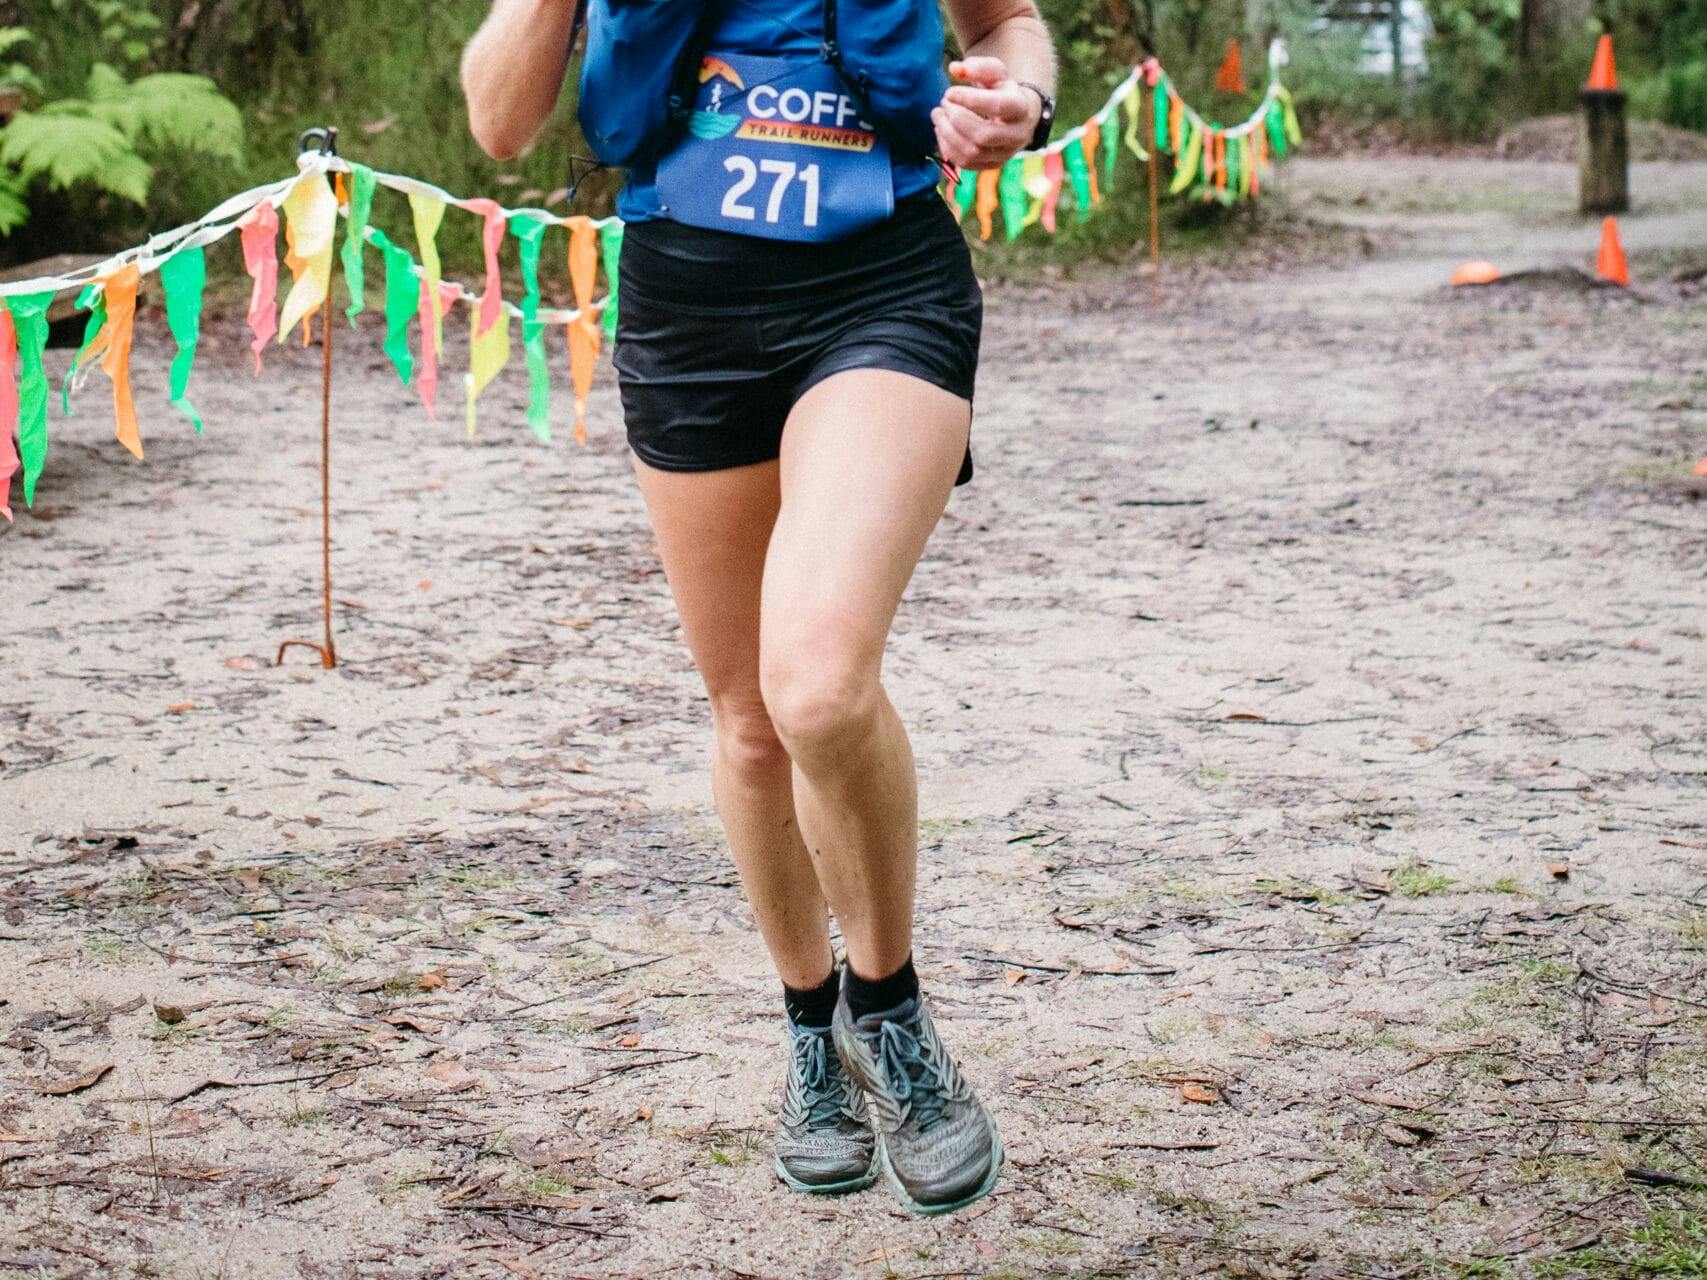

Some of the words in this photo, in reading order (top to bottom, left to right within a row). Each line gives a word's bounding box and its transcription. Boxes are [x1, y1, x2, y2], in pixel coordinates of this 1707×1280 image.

[747, 85, 874, 131] COFF
[750, 124, 793, 138] TRAIL
[800, 128, 869, 147] RUNNERS
[721, 155, 820, 227] 271
